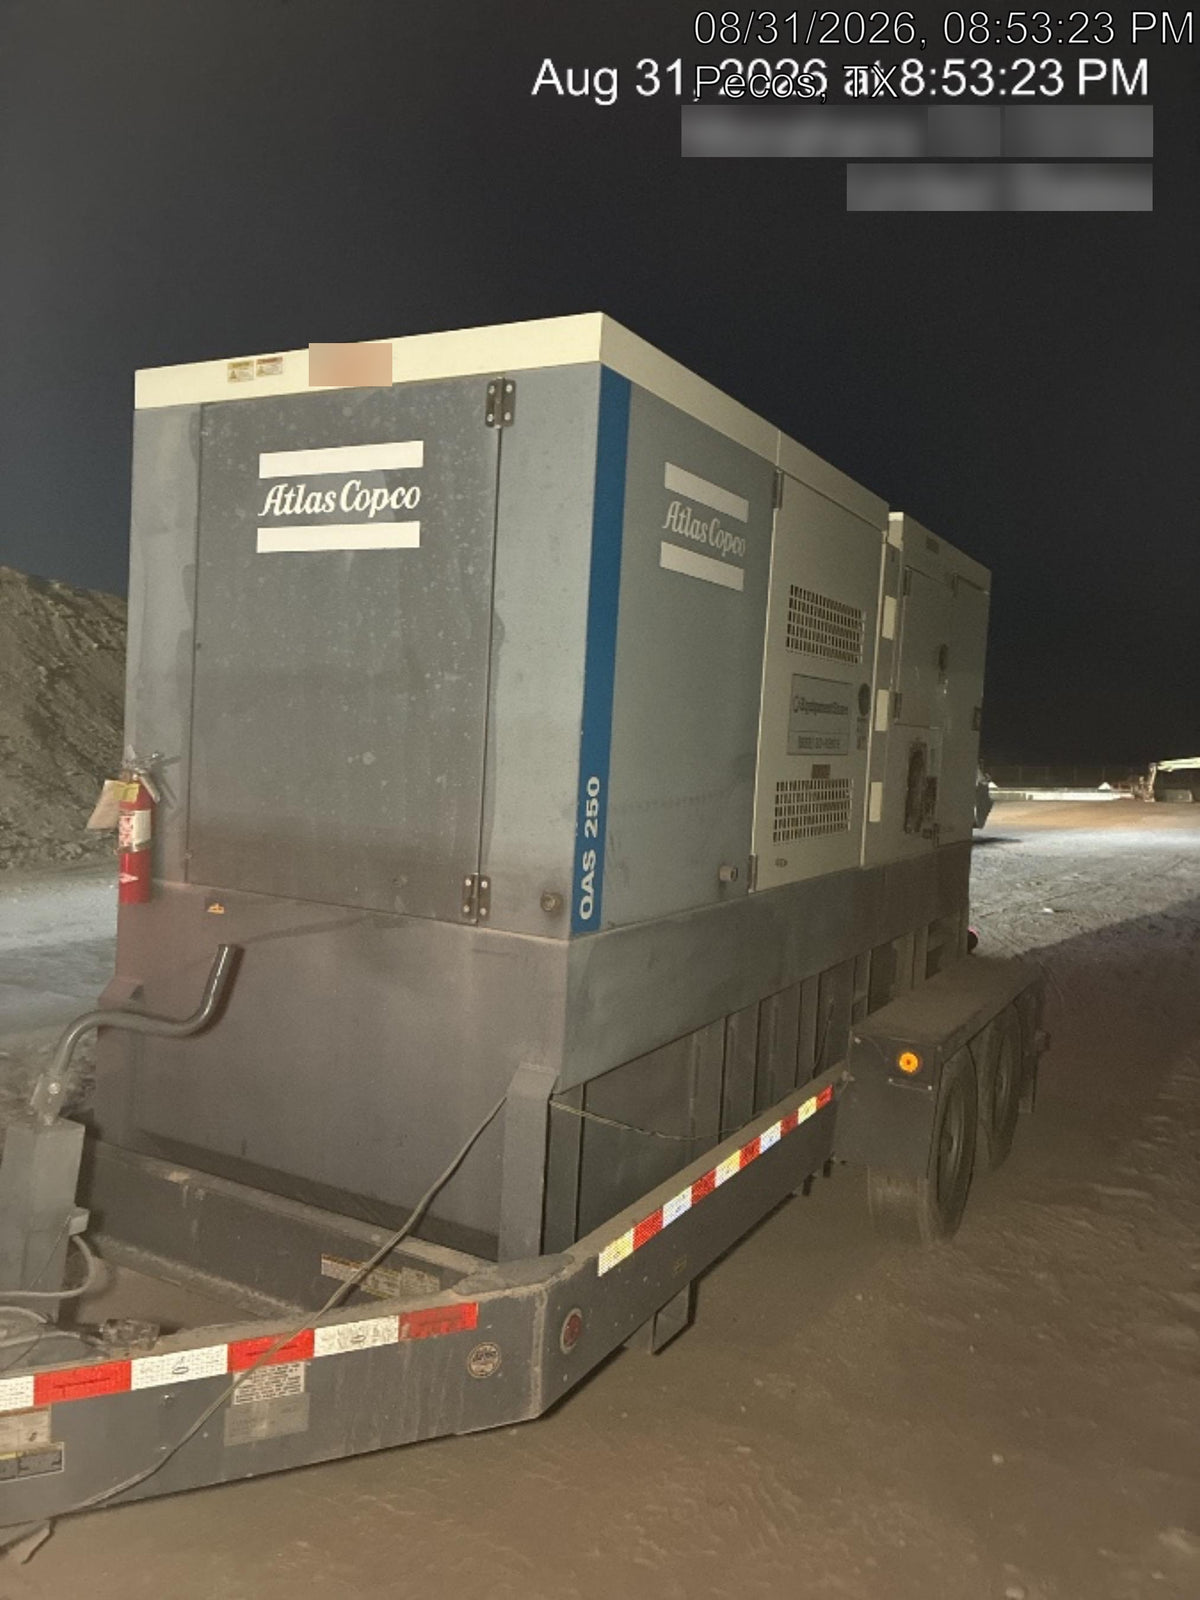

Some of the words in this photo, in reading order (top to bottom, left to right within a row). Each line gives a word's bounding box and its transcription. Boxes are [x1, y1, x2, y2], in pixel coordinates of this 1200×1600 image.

[257, 482, 336, 517] Atlas
[339, 479, 421, 518] Copco
[662, 500, 709, 544] Atlas
[707, 517, 747, 558] Copco
[584, 776, 601, 839] 250
